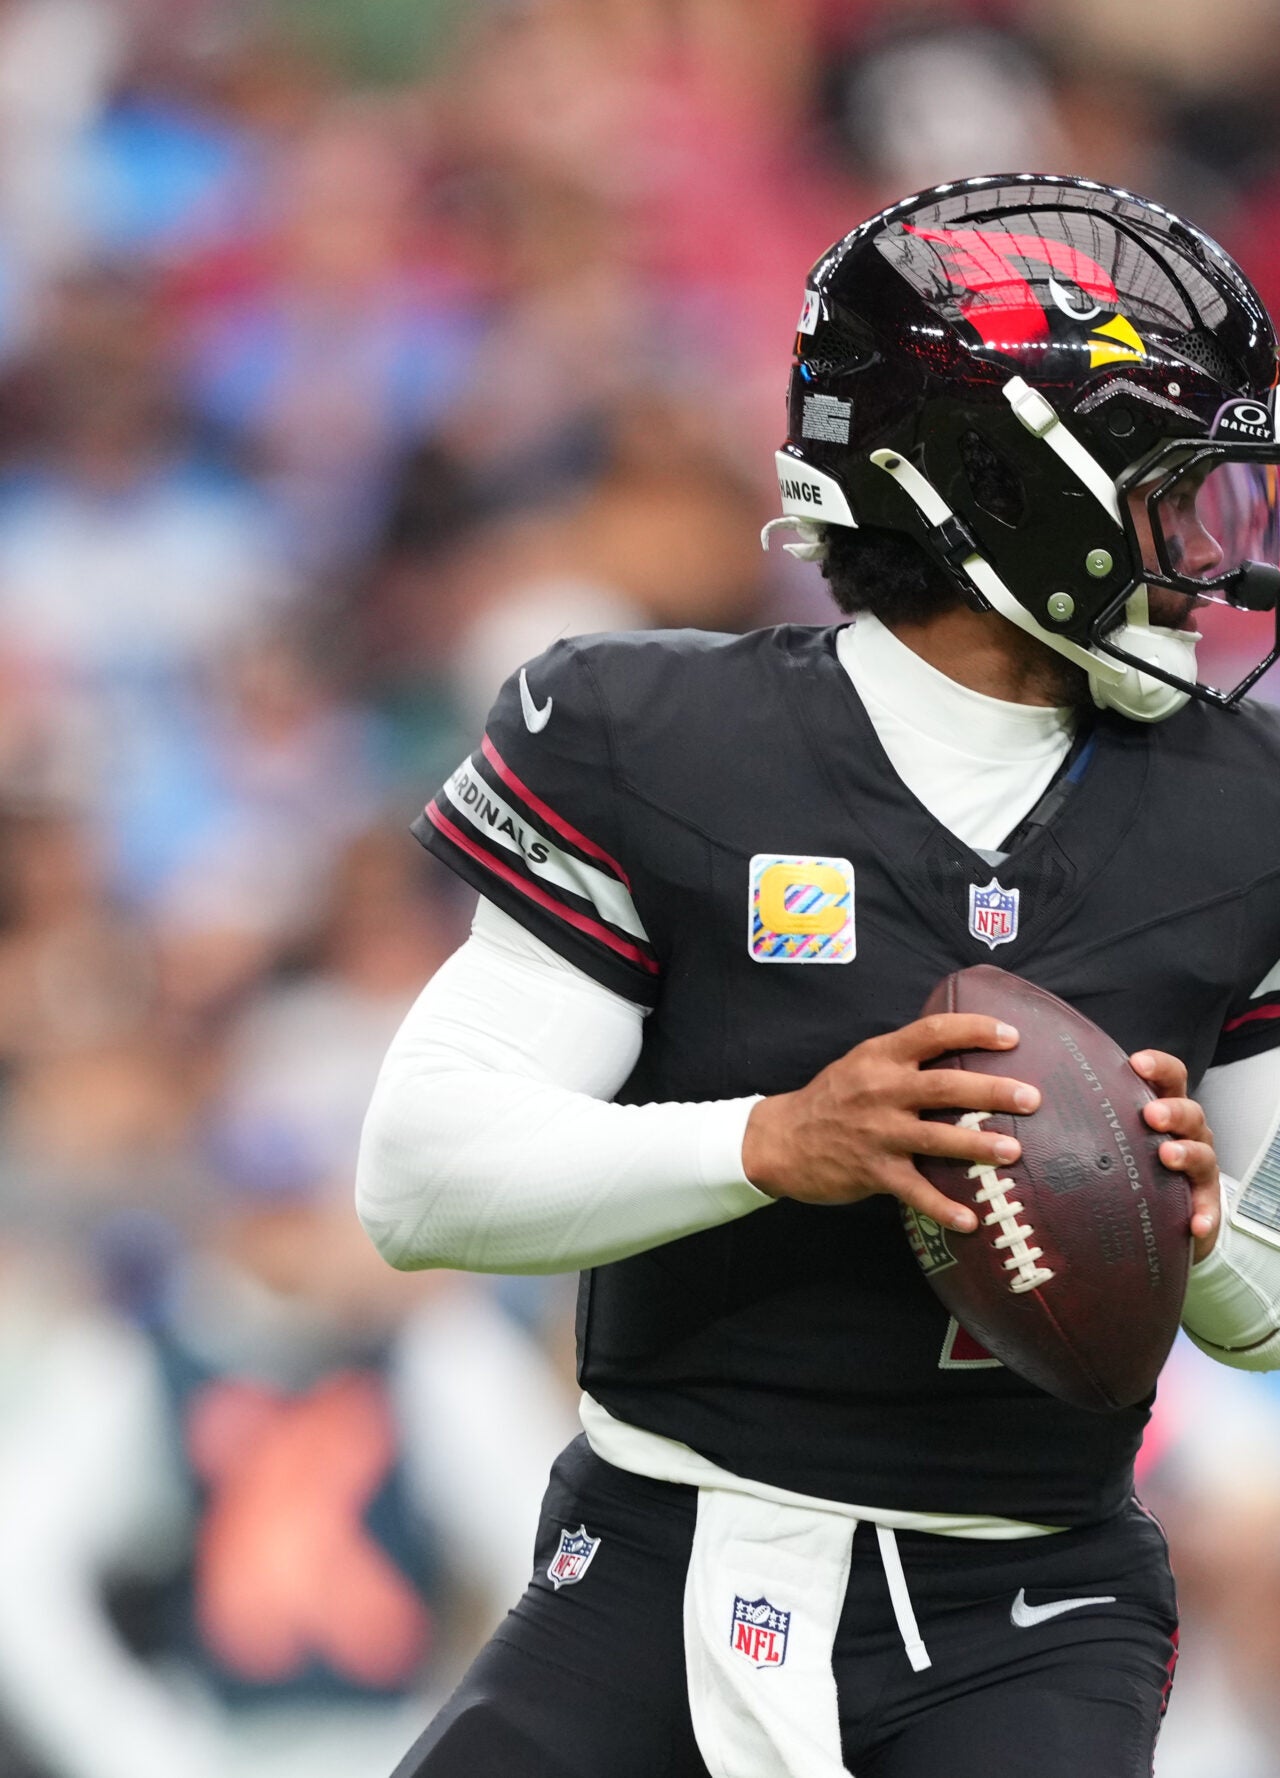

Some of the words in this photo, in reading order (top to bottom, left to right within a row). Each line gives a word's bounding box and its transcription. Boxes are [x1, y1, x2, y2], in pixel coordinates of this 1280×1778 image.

[1220, 418, 1271, 439] OAKLEY
[452, 773, 550, 864] RDINALS
[760, 864, 848, 935] C
[977, 910, 1010, 937] NFL
[1059, 1031, 1104, 1092] LEAGUE
[1100, 1097, 1143, 1192] FOOTBALL
[554, 1553, 581, 1578] NFL
[735, 1623, 779, 1662] NFL
